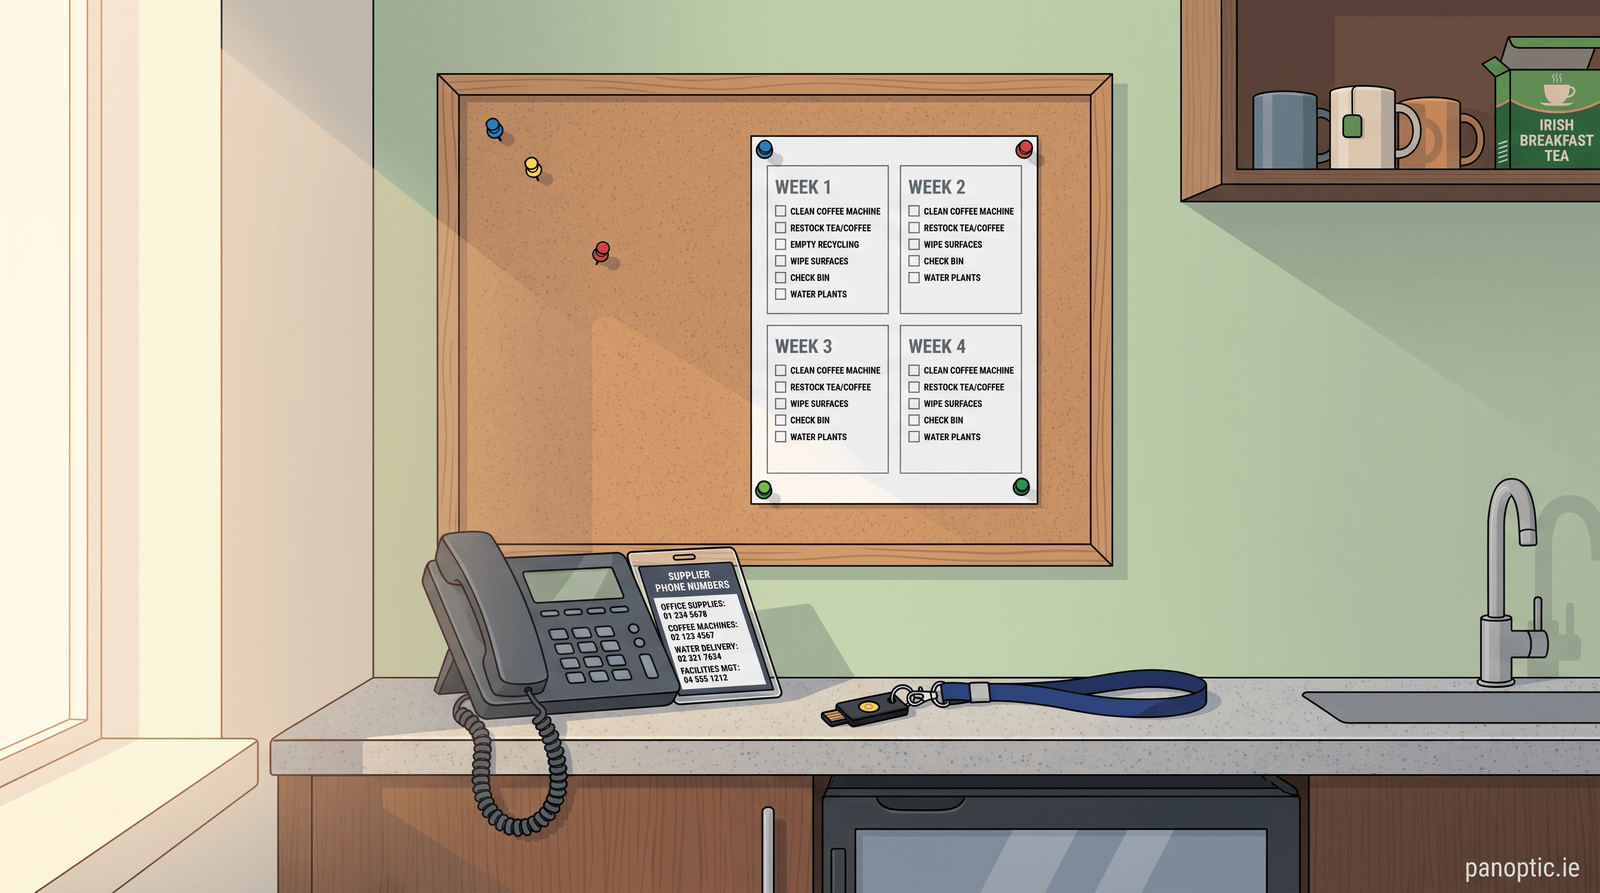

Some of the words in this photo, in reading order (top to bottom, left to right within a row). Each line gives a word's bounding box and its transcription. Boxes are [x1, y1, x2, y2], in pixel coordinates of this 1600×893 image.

[1540, 119, 1573, 130] IRISH
[1520, 134, 1594, 146] BREAKFAST
[1544, 149, 1569, 161] TEA
[775, 179, 818, 194] WEEK
[824, 179, 830, 194] 1
[909, 179, 951, 194] WEEK
[957, 179, 965, 194] 2
[790, 207, 814, 216] CLEAN
[817, 207, 844, 215] COFFEE
[846, 207, 880, 215] MACHINE
[924, 207, 948, 216] CLEAN
[950, 207, 978, 215] COFFEE
[980, 207, 1014, 216] MACHINE
[791, 224, 824, 232] RESTOCK
[826, 224, 871, 232] TEA/COFFEE
[924, 224, 958, 232] RESTOCK
[960, 224, 1004, 232] TEA/COFFEE
[791, 240, 816, 249] EMPTY
[818, 240, 859, 249] RECYCLING
[924, 240, 942, 249] WIPE
[945, 240, 982, 249] SURFACES
[790, 257, 809, 265] WIPE
[811, 257, 848, 265] SURFACES
[924, 257, 949, 265] CHECK
[951, 257, 963, 265] BIN
[790, 273, 815, 282] CHECK
[817, 273, 829, 282] BIN
[924, 273, 949, 282] WATER
[951, 273, 981, 282] PLANTS
[790, 290, 816, 298] WATER
[818, 290, 847, 298] PLANTS
[776, 338, 818, 353] WEEK
[823, 338, 832, 353] 3
[909, 338, 952, 353] WEEK
[957, 338, 966, 353] 4
[790, 366, 815, 375] CLEAN
[817, 366, 844, 375] COFFEE
[846, 366, 880, 375] MACHINE
[924, 366, 948, 375] CLEAN
[950, 366, 978, 375] COFFEE
[980, 366, 1014, 375] MACHINE
[791, 383, 824, 391] RESTOCK
[826, 383, 871, 391] TEA/COFFEE
[924, 383, 958, 391] RESTOCK
[960, 383, 1004, 391] TEA/COFFEE
[790, 399, 809, 408] WIPE
[811, 399, 848, 408] SURFACES
[924, 399, 942, 408] WIPE
[945, 399, 982, 408] SURFACES
[791, 416, 815, 424] CHECK
[817, 416, 829, 424] BIN
[924, 416, 949, 424] CHECK
[951, 416, 963, 424] BIN
[790, 432, 815, 441] WATER
[818, 432, 847, 441] PLANTS
[924, 432, 949, 441] WATER
[951, 432, 981, 441] PLANTS
[668, 570, 710, 581] SUPPLIER
[655, 583, 686, 592] PHONE
[688, 580, 730, 591] NUMBERS
[661, 602, 686, 610] OFFICE
[688, 600, 725, 609] SUPPLIES:
[668, 623, 695, 632] COFFEE
[697, 621, 738, 630] MACHINES:
[671, 633, 680, 641] 02
[675, 645, 700, 653] WATER
[702, 643, 738, 652] DELIVERY:
[678, 654, 687, 662] 02
[680, 666, 719, 674] FACILITIES
[721, 664, 740, 672] MGT:
[710, 674, 728, 682] 1212
